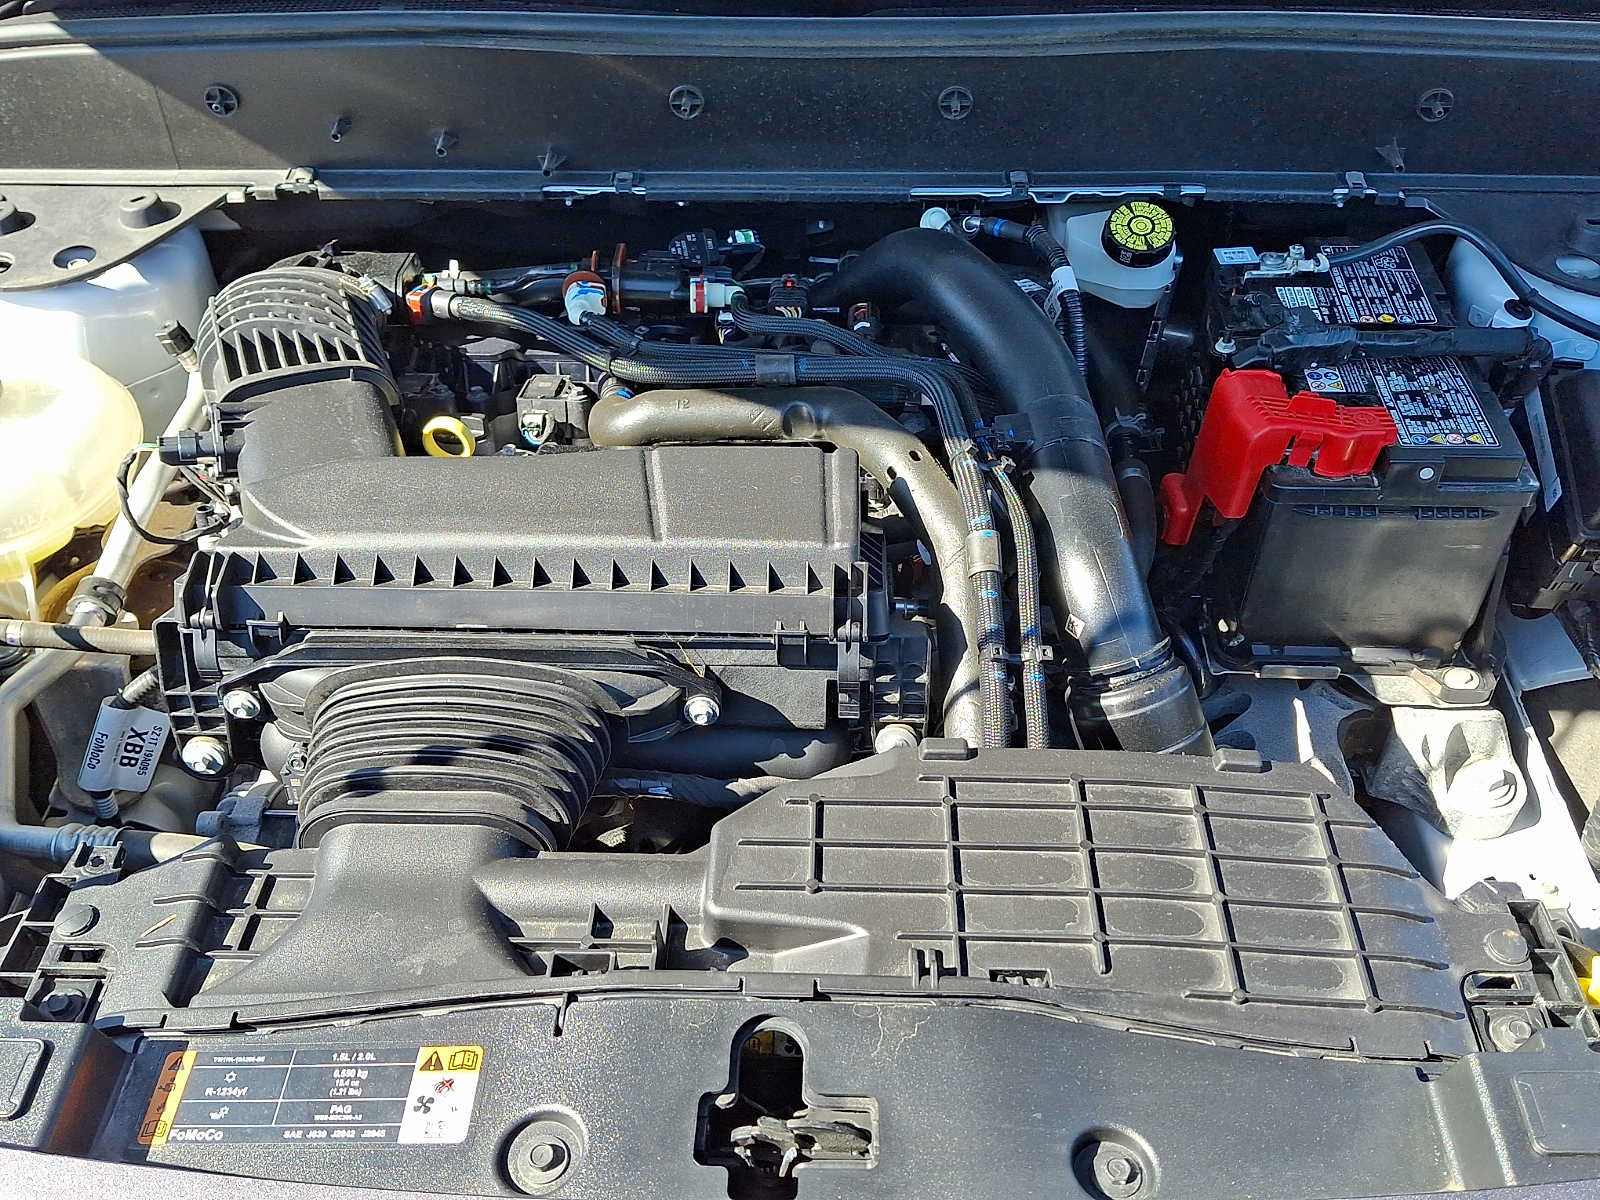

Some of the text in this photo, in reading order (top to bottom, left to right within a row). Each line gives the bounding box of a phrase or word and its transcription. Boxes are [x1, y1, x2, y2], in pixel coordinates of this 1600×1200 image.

[87, 731, 109, 770] FoMoCo
[119, 727, 150, 767] XBB
[204, 1086, 249, 1098] R-1234yf
[329, 1104, 353, 1114] PAG
[167, 1128, 225, 1142] FoMoCo
[283, 1130, 304, 1139] SAE
